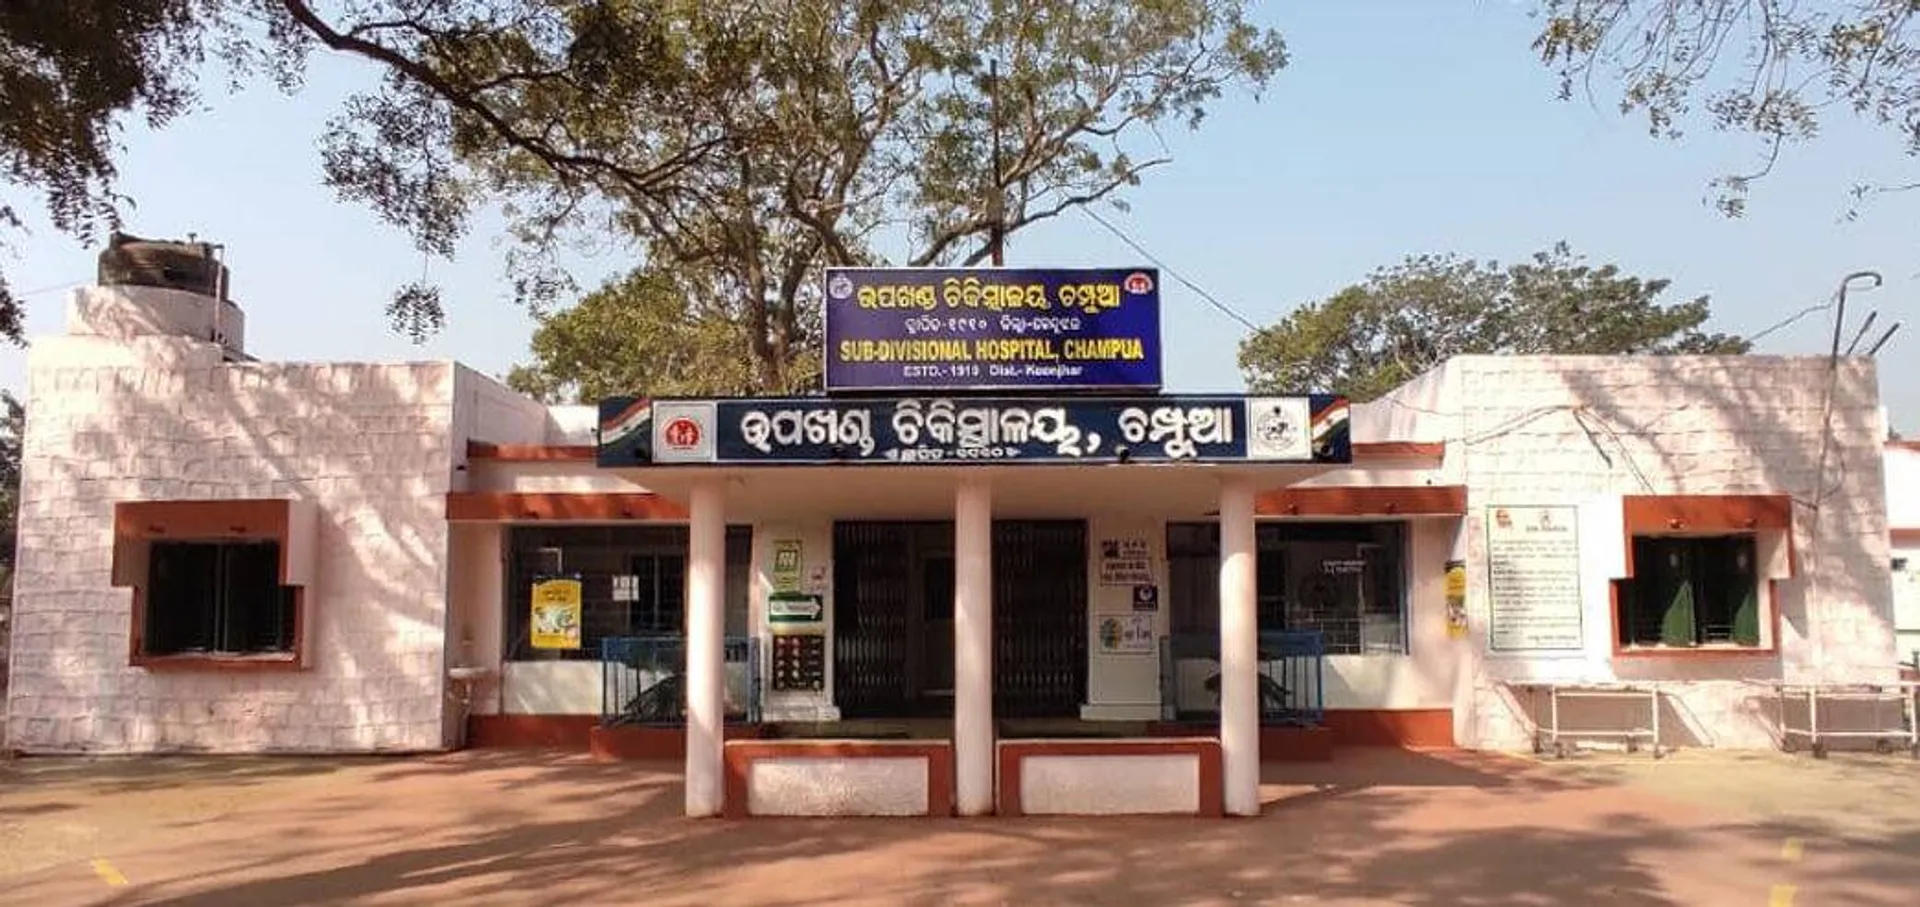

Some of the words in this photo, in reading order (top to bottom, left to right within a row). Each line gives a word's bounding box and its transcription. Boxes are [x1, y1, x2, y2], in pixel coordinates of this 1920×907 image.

[857, 284, 938, 310] ଉପଖଣ୍ଡ
[1059, 284, 1120, 313] ଚମ୍ପୁଆ
[840, 339, 972, 361] SUB-DIVISIONAL
[975, 338, 1059, 362] HOSPITAL,
[1064, 338, 1144, 360] CHAMPUA
[741, 409, 875, 456] ଉପଖଣ୍ଡ
[1118, 407, 1233, 458] ଚମ୍ପୁଆ
